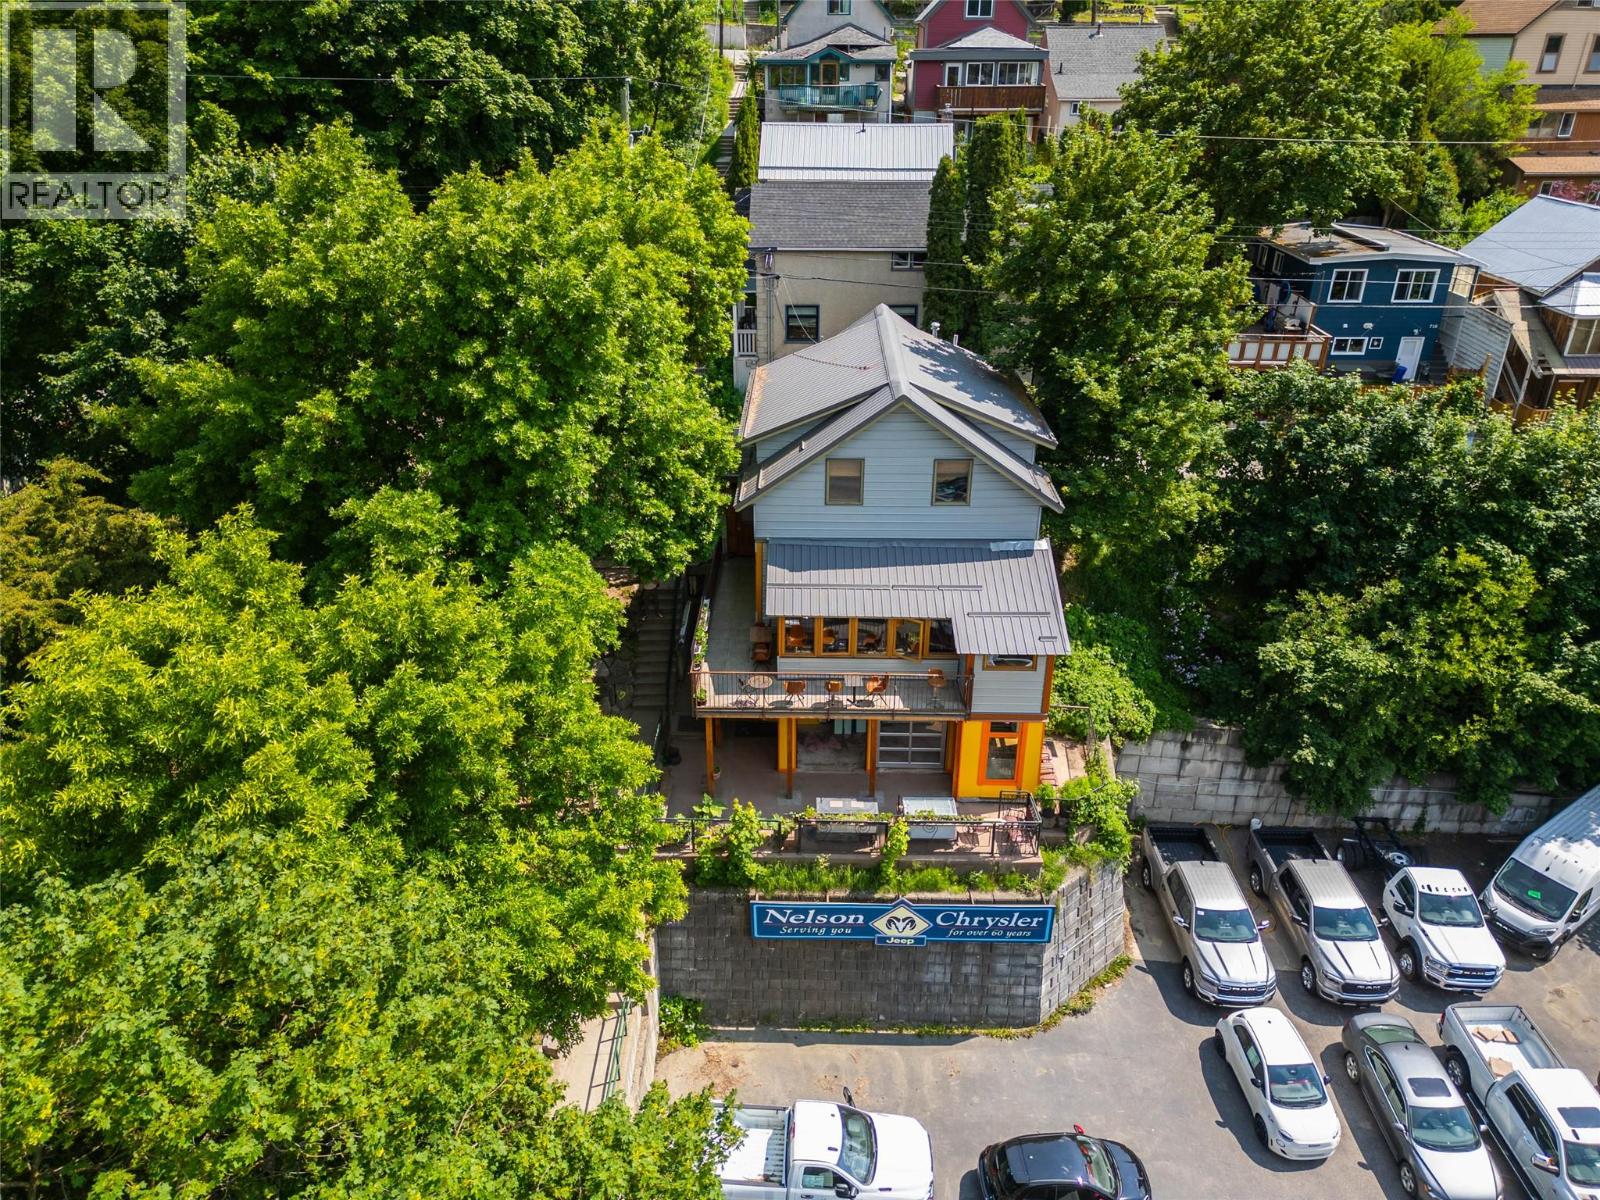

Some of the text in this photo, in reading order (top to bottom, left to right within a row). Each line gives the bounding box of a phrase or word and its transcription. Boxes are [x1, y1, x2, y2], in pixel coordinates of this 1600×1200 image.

[763, 909, 1044, 929] Nelson Chrysler
[779, 926, 826, 936] Serving
[831, 927, 852, 936] you
[948, 928, 964, 938] for
[991, 929, 1003, 937] 60
[1006, 931, 1031, 939] years
[886, 937, 915, 946] Jeep
